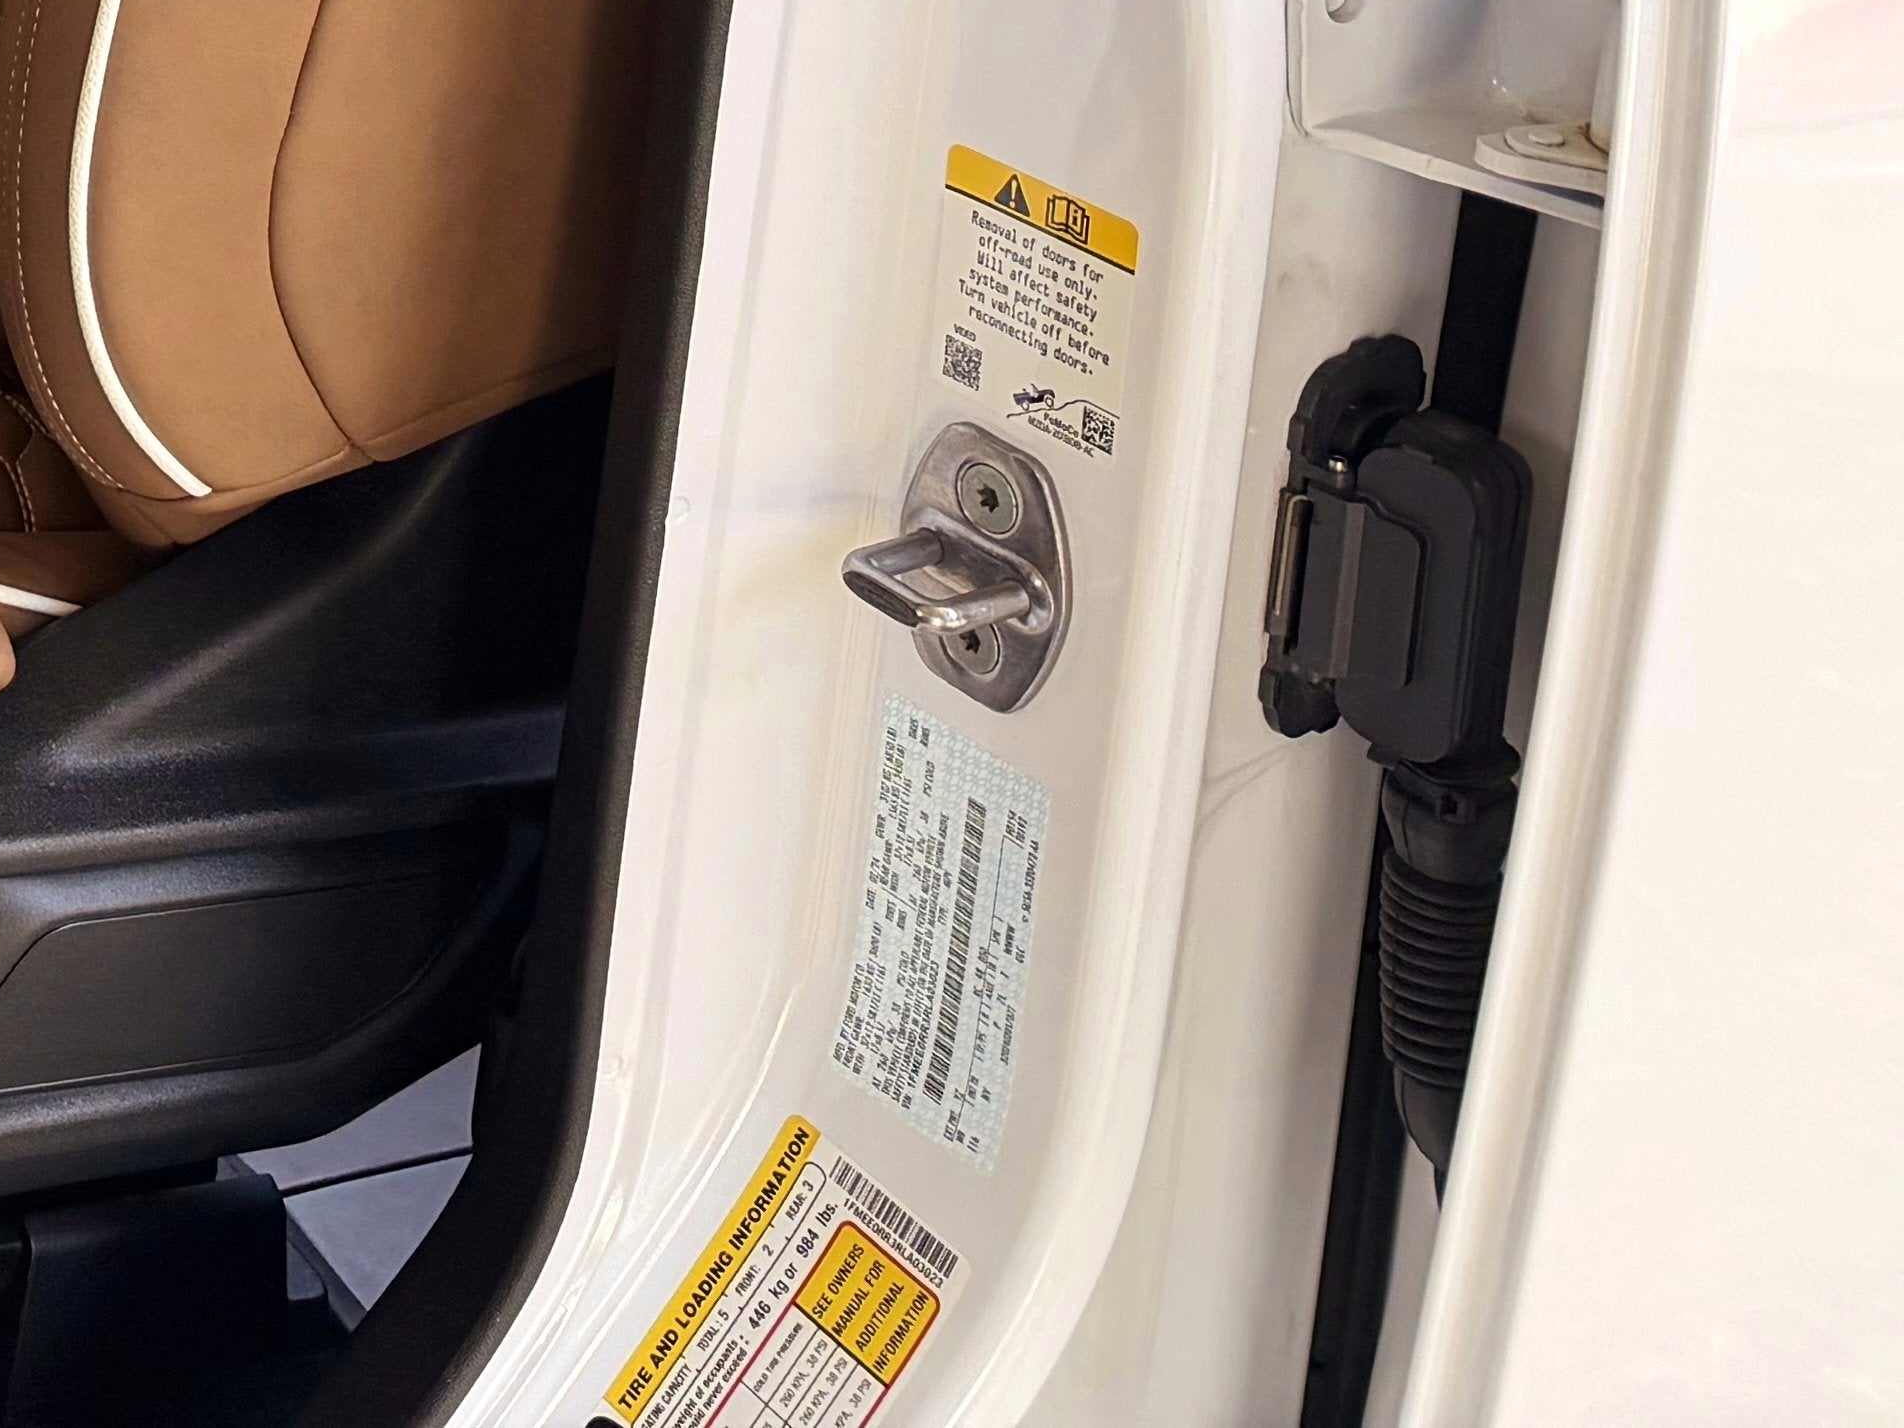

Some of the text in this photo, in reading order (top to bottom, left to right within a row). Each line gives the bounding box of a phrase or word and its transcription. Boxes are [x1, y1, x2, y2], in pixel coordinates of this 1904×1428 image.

[970, 208, 1104, 285] Removal of doors for
[977, 231, 1098, 305] off-road use only.
[957, 277, 1110, 366] Turn vehicle off before
[967, 266, 1095, 338] system performance.
[976, 249, 1098, 324] Will affect safety
[968, 303, 1094, 377] reconnecting doors.
[800, 1178, 814, 1192] 3
[616, 1125, 811, 1413] TIRE AND LOADING INFORMATION
[745, 1197, 839, 1332] 446 kg or 984 lbs.
[760, 1242, 775, 1257] 2
[809, 1241, 867, 1321] SEE OWNERS
[715, 1306, 731, 1322] 5
[829, 1258, 887, 1338] MANUAL FOR
[851, 1277, 907, 1353] ADDITIONAL
[870, 1288, 930, 1374] INFORMATION
[691, 1383, 707, 1401] of
[701, 1380, 725, 1411] never
